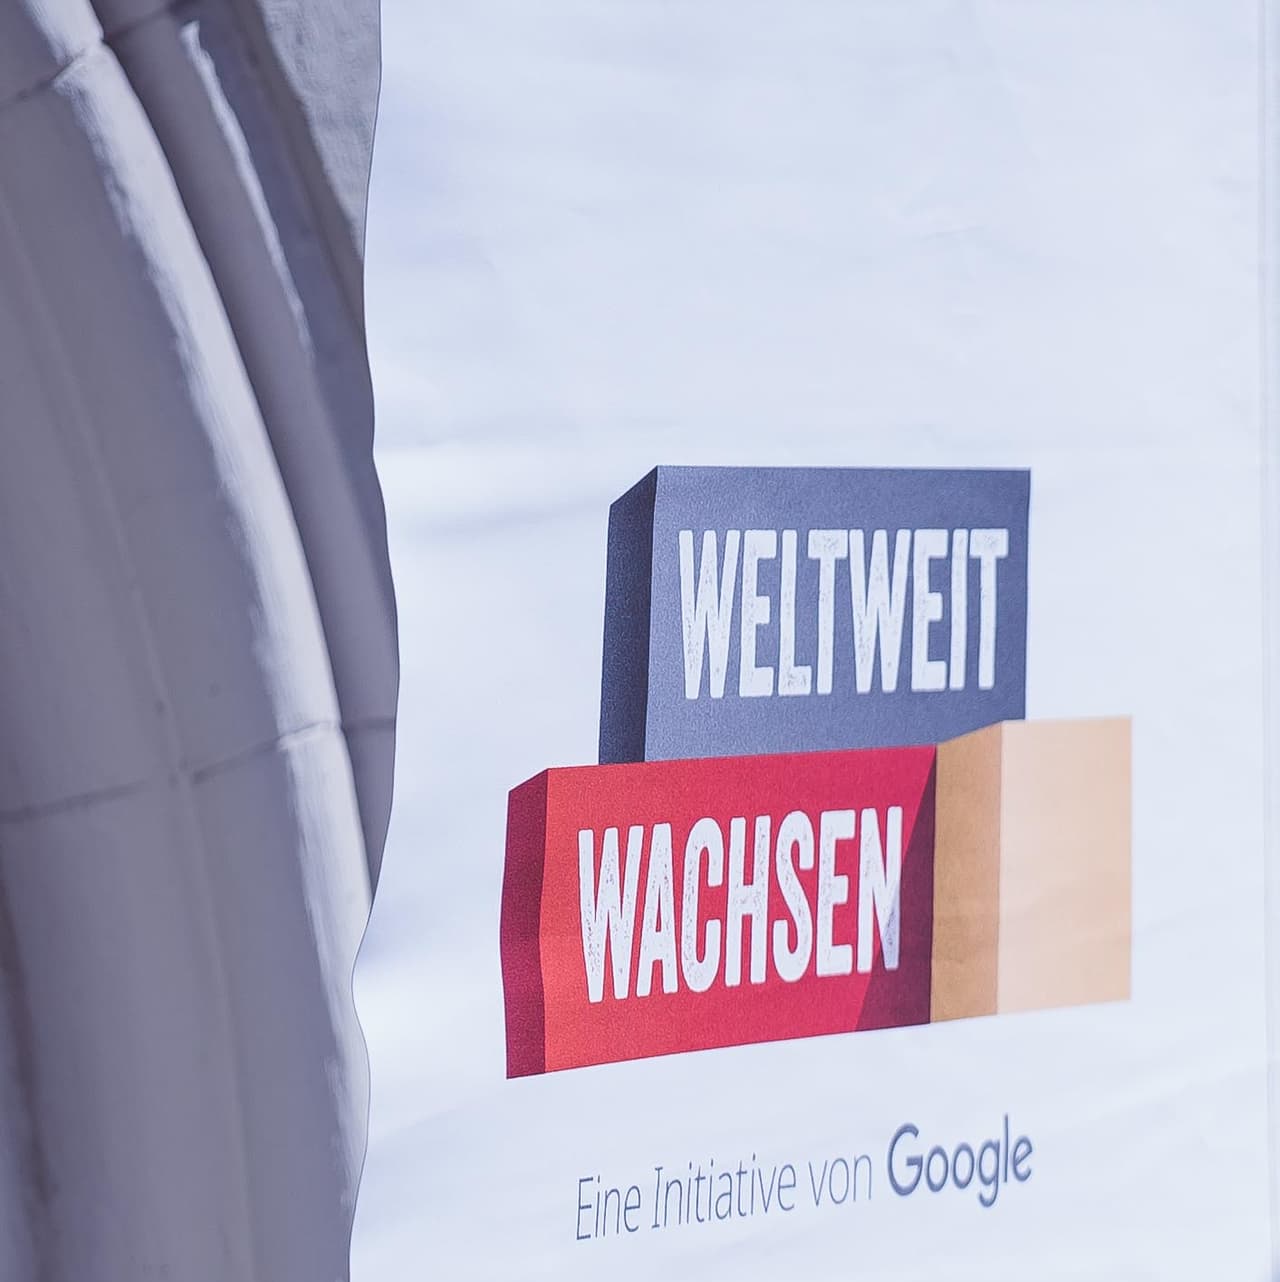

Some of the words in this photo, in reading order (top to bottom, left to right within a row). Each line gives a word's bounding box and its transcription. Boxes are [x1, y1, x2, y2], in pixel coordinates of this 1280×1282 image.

[678, 528, 1009, 700] WELTWEIT
[577, 805, 903, 1004] WACHSEN
[576, 1175, 641, 1241] Eine
[651, 1152, 797, 1229] Initiative
[808, 1154, 872, 1207] von
[886, 1112, 1033, 1208] Google
